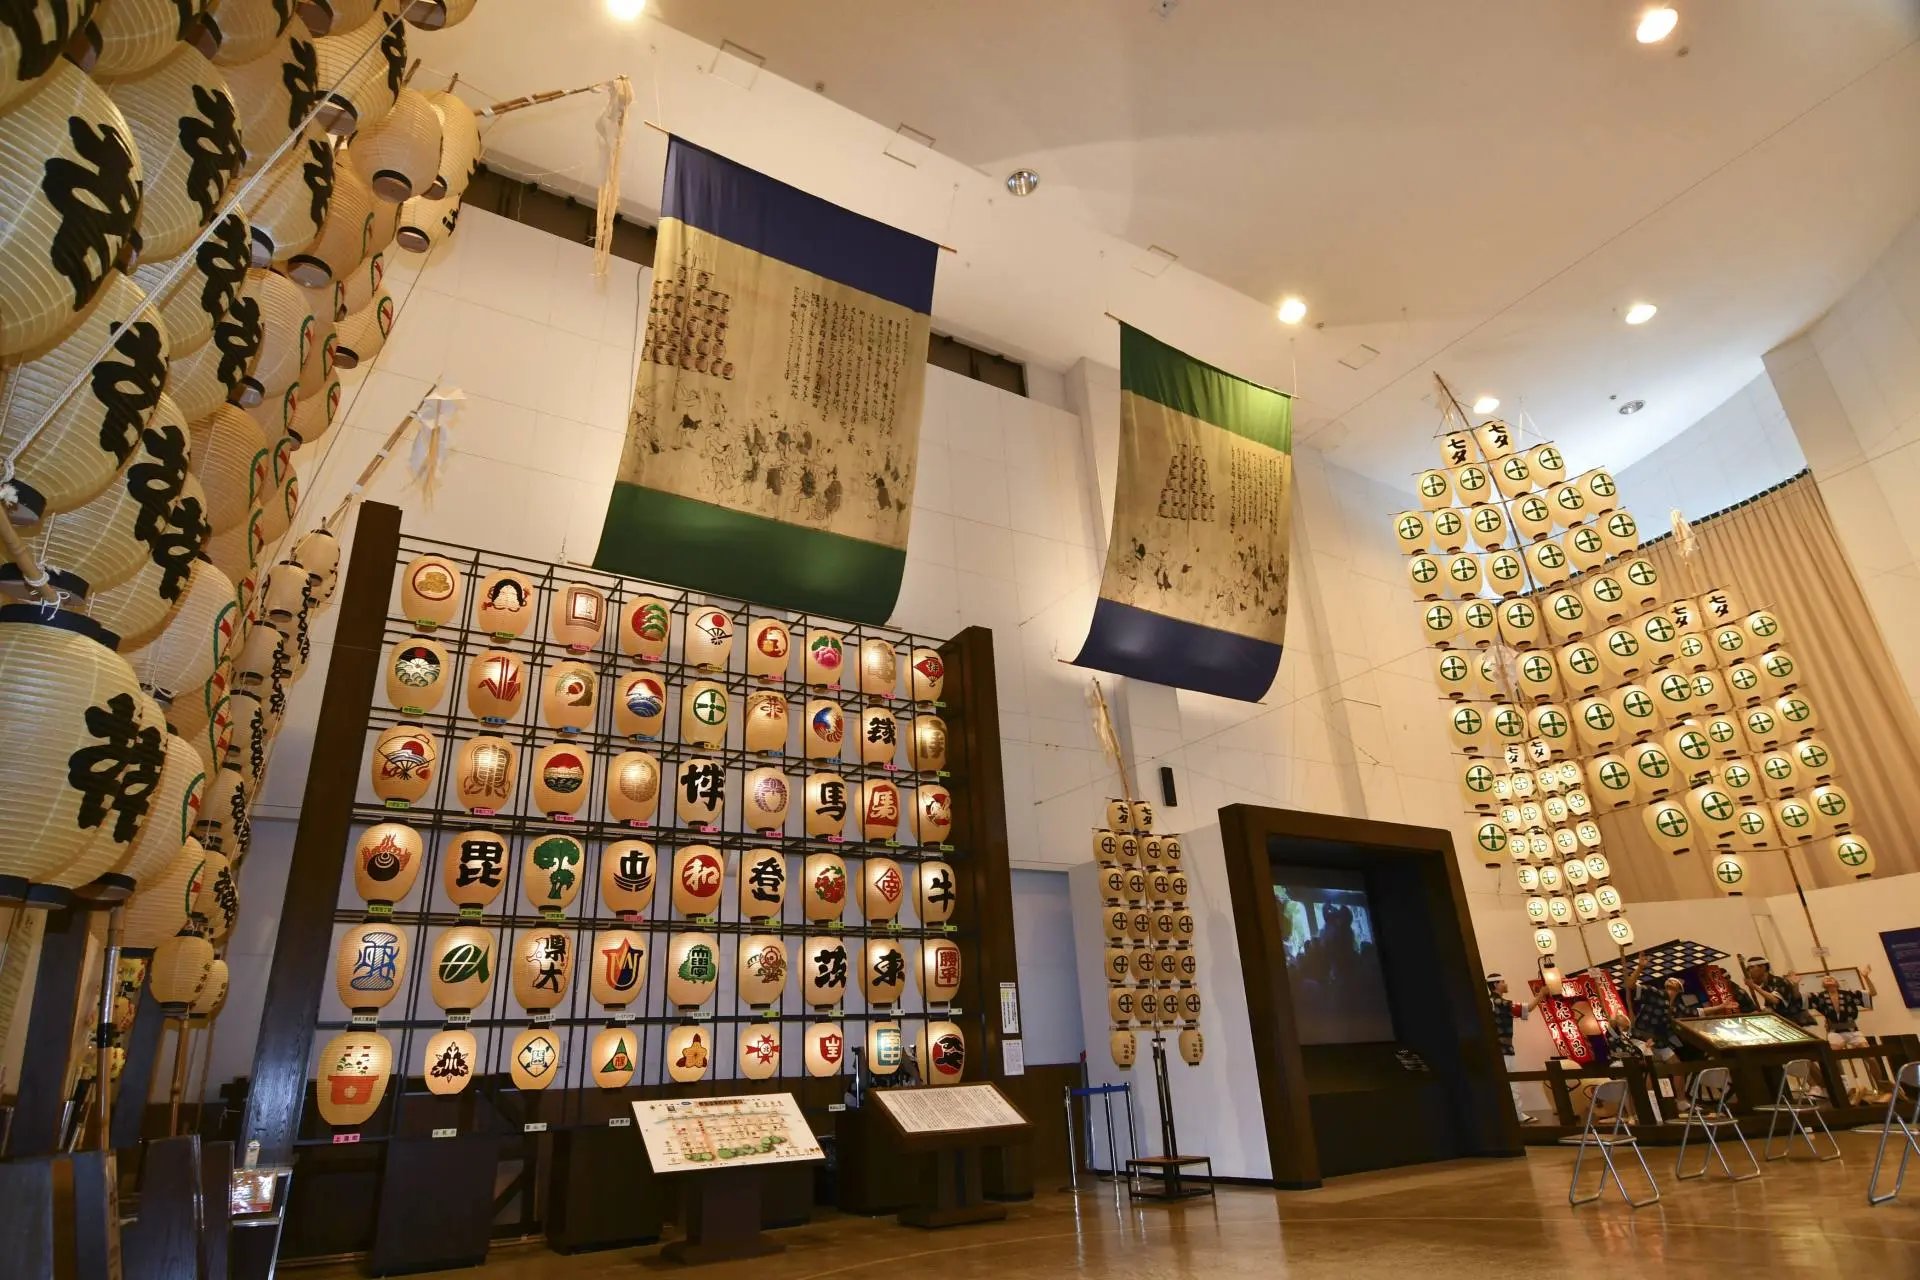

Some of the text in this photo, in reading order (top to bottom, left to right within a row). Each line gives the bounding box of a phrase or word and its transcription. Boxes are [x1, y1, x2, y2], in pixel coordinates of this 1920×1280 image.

[1447, 438, 1467, 465] 七夕
[1488, 424, 1509, 449] 七夕
[1671, 606, 1688, 628] 七夕
[1709, 595, 1729, 618] 七夕
[816, 781, 847, 822] 馬
[456, 840, 504, 888] 毘
[683, 858, 720, 892] 和
[927, 868, 956, 913] 牛
[535, 934, 567, 993] 県大
[825, 1037, 839, 1059] 山王
